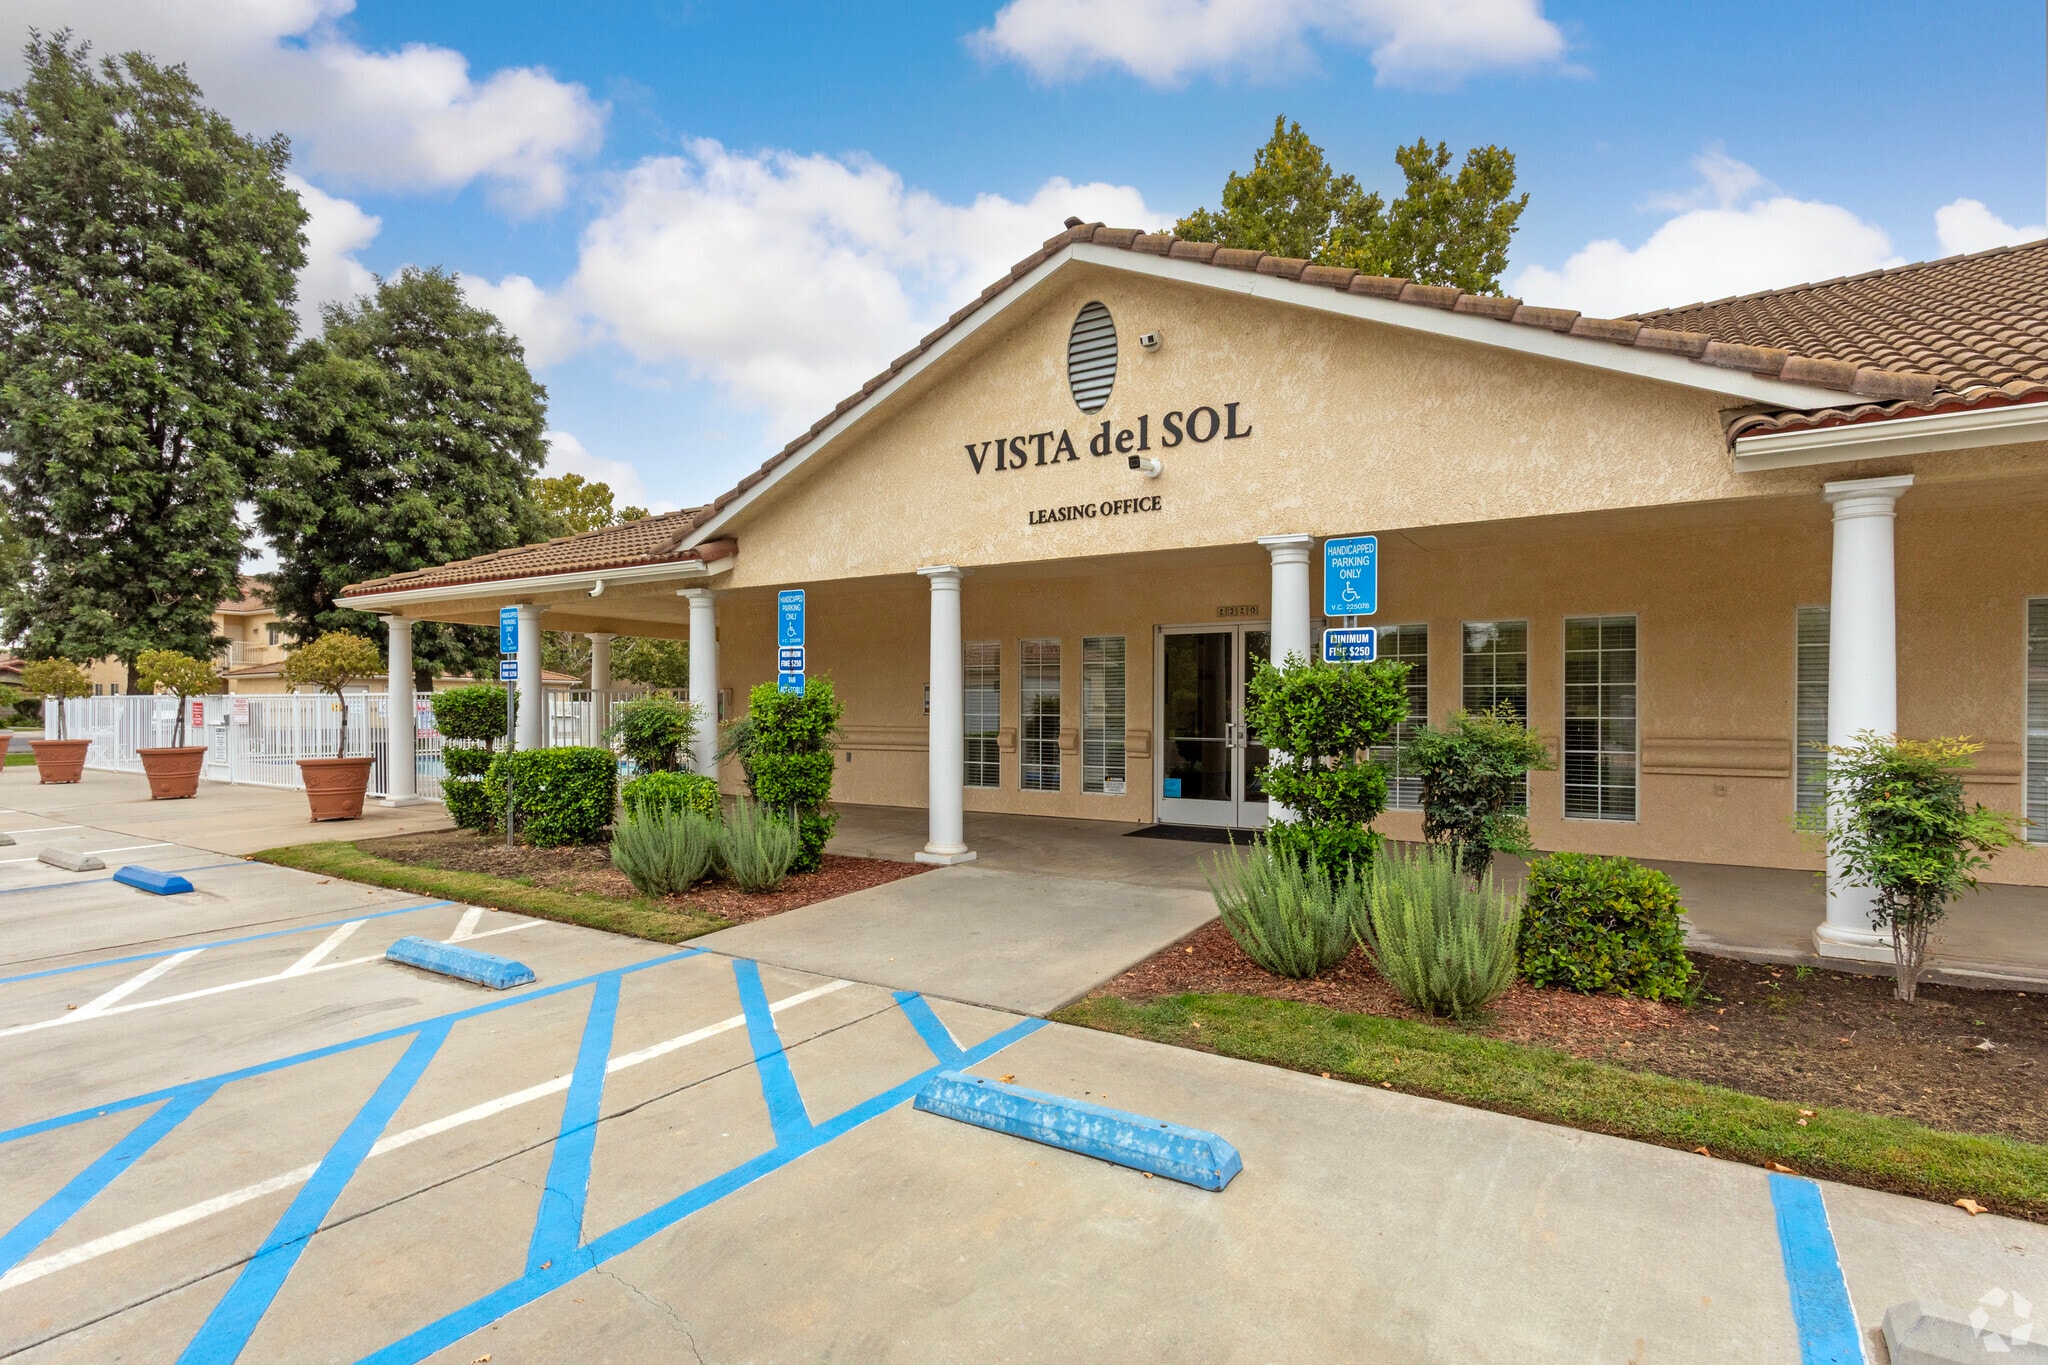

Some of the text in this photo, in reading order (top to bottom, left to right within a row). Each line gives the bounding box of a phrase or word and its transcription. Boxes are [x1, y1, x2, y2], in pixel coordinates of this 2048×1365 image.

[964, 402, 1252, 474] VISTA del SOL
[1029, 495, 1162, 525] LEASING OFFICE
[1328, 543, 1374, 556] HANDICAPPED
[1332, 555, 1370, 567] PARKING
[1340, 568, 1362, 579] ONLY
[782, 603, 801, 612] PARKING
[1330, 633, 1369, 644] MINIMUM
[1349, 646, 1370, 657] $250
